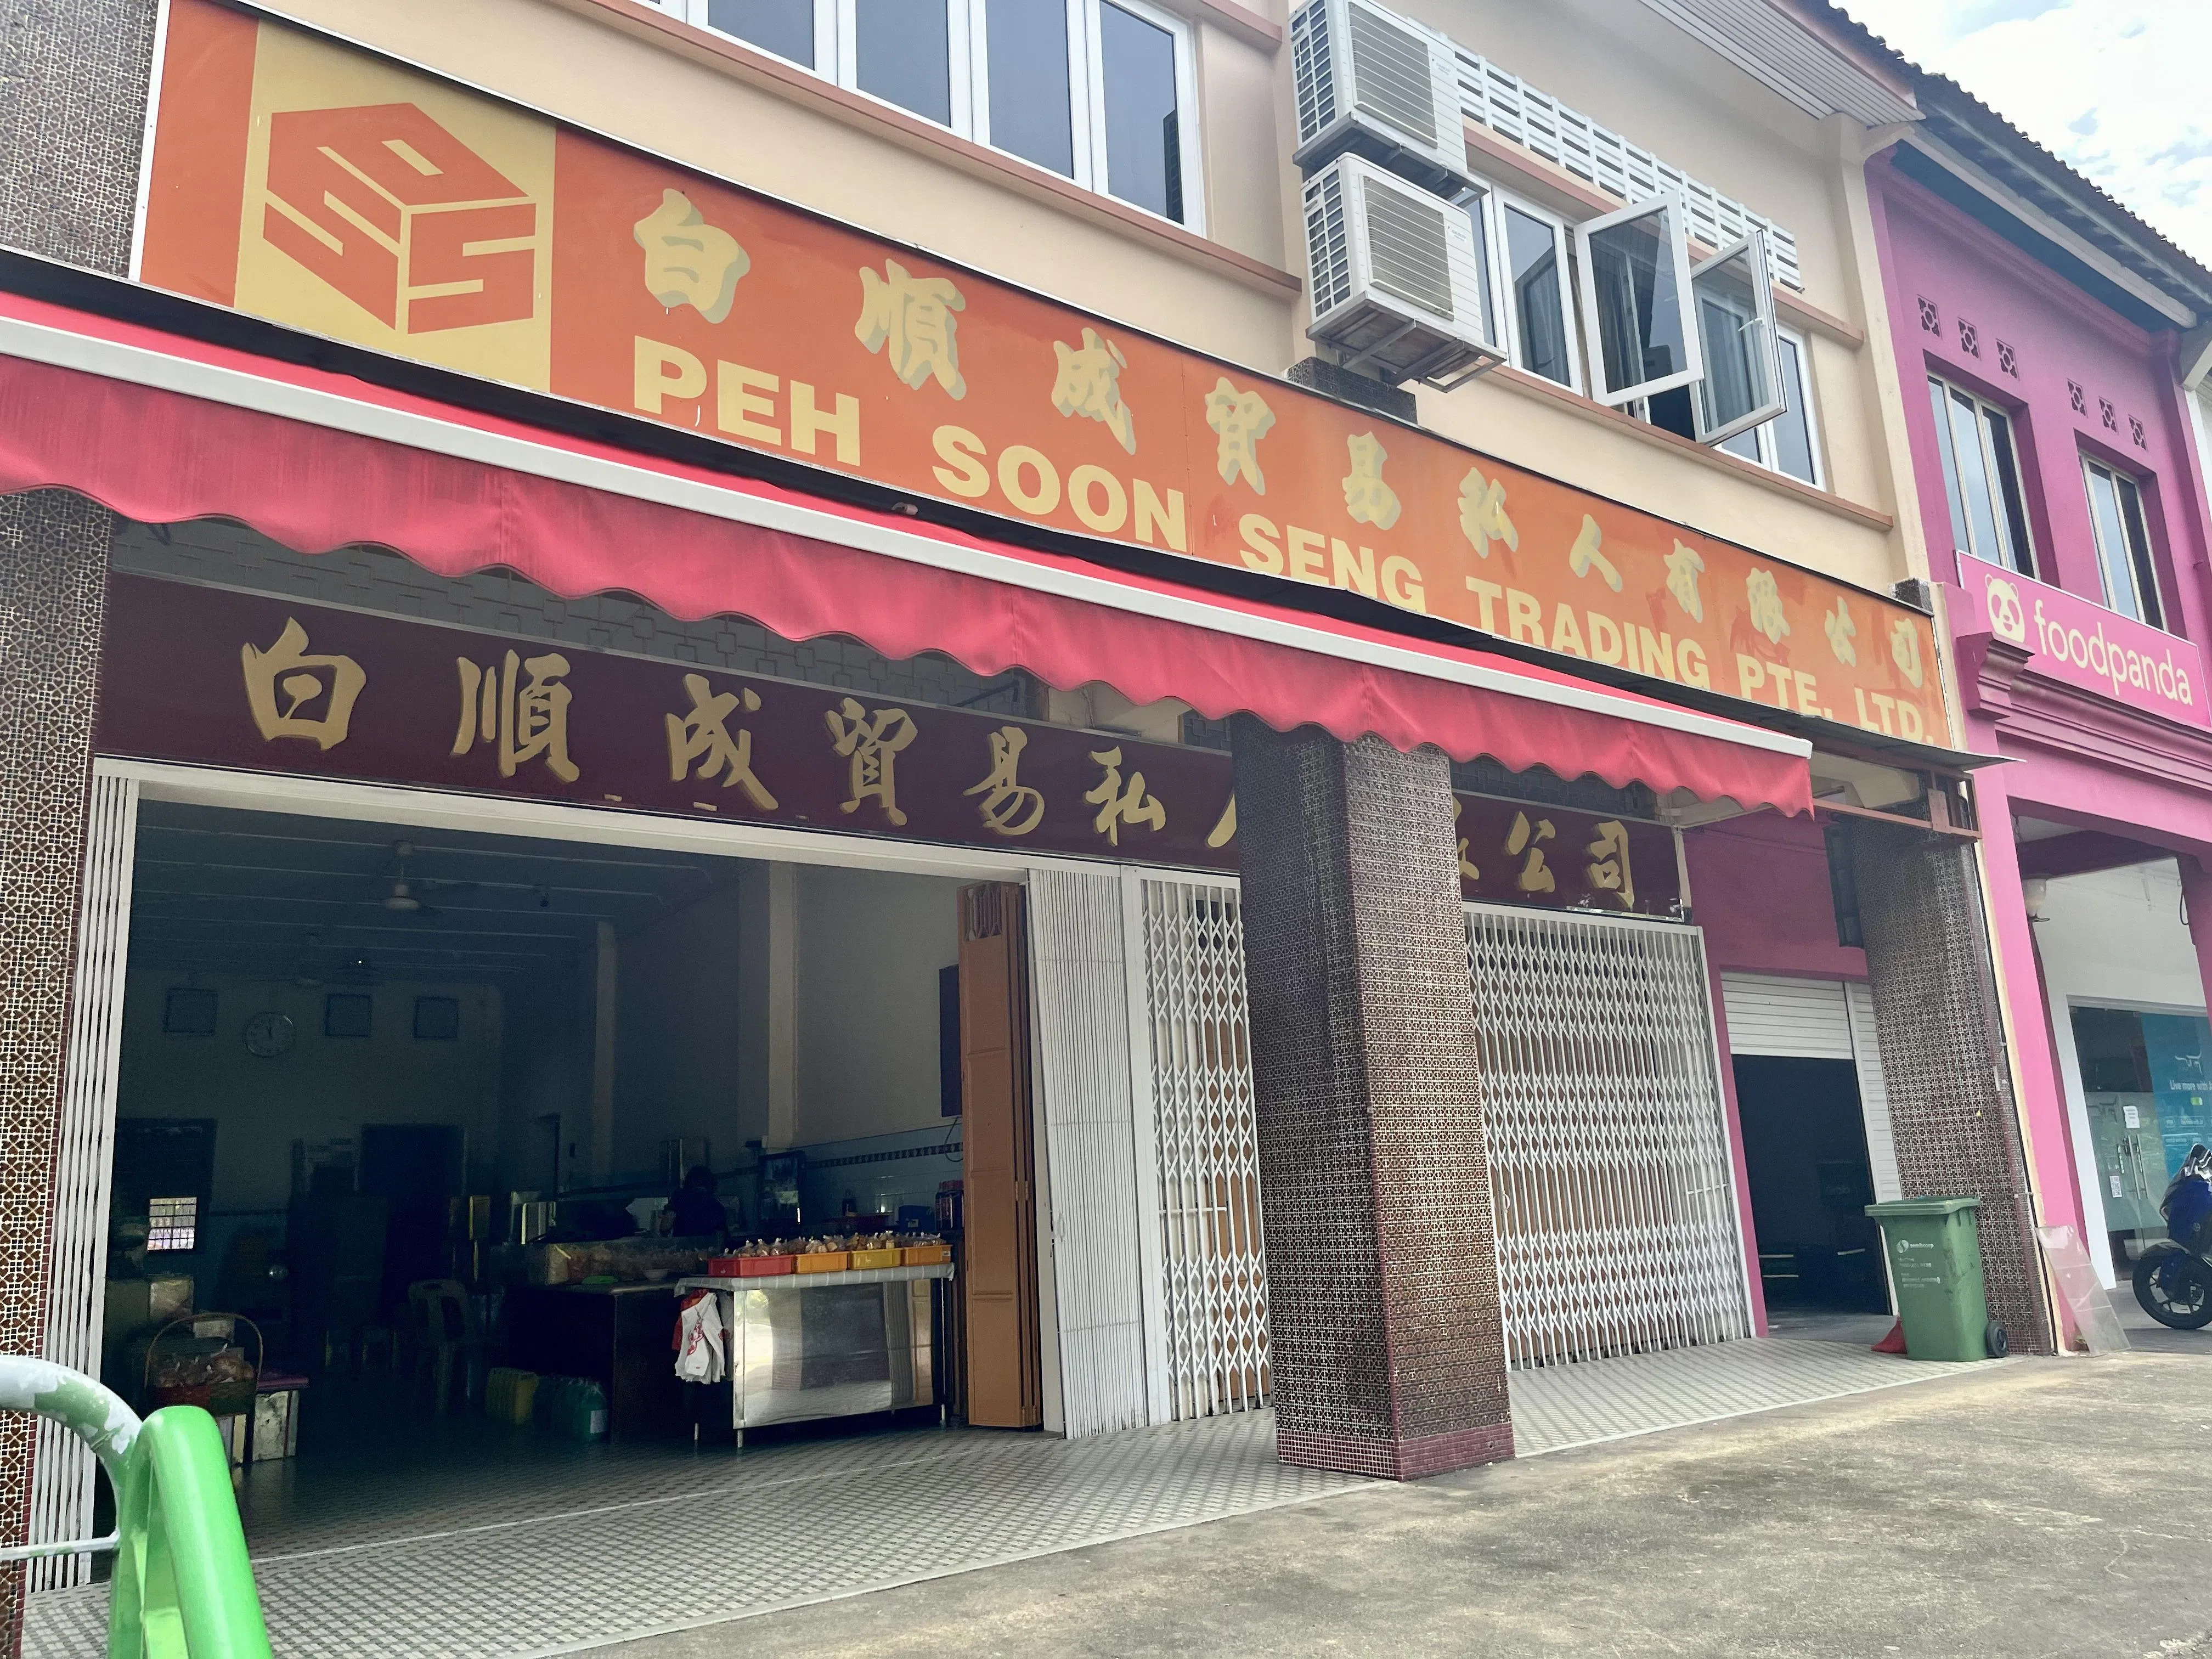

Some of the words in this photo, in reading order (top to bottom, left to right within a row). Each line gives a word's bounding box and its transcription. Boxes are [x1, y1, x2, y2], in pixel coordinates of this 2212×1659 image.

[634, 336, 860, 467] PEH
[932, 425, 1187, 553] SOON
[1239, 514, 1426, 614] SENG
[1465, 575, 1711, 690] TRADING
[1736, 653, 1833, 719] PTE.
[1855, 687, 1934, 745] LTD.
[2033, 599, 2193, 707] foodpanda
